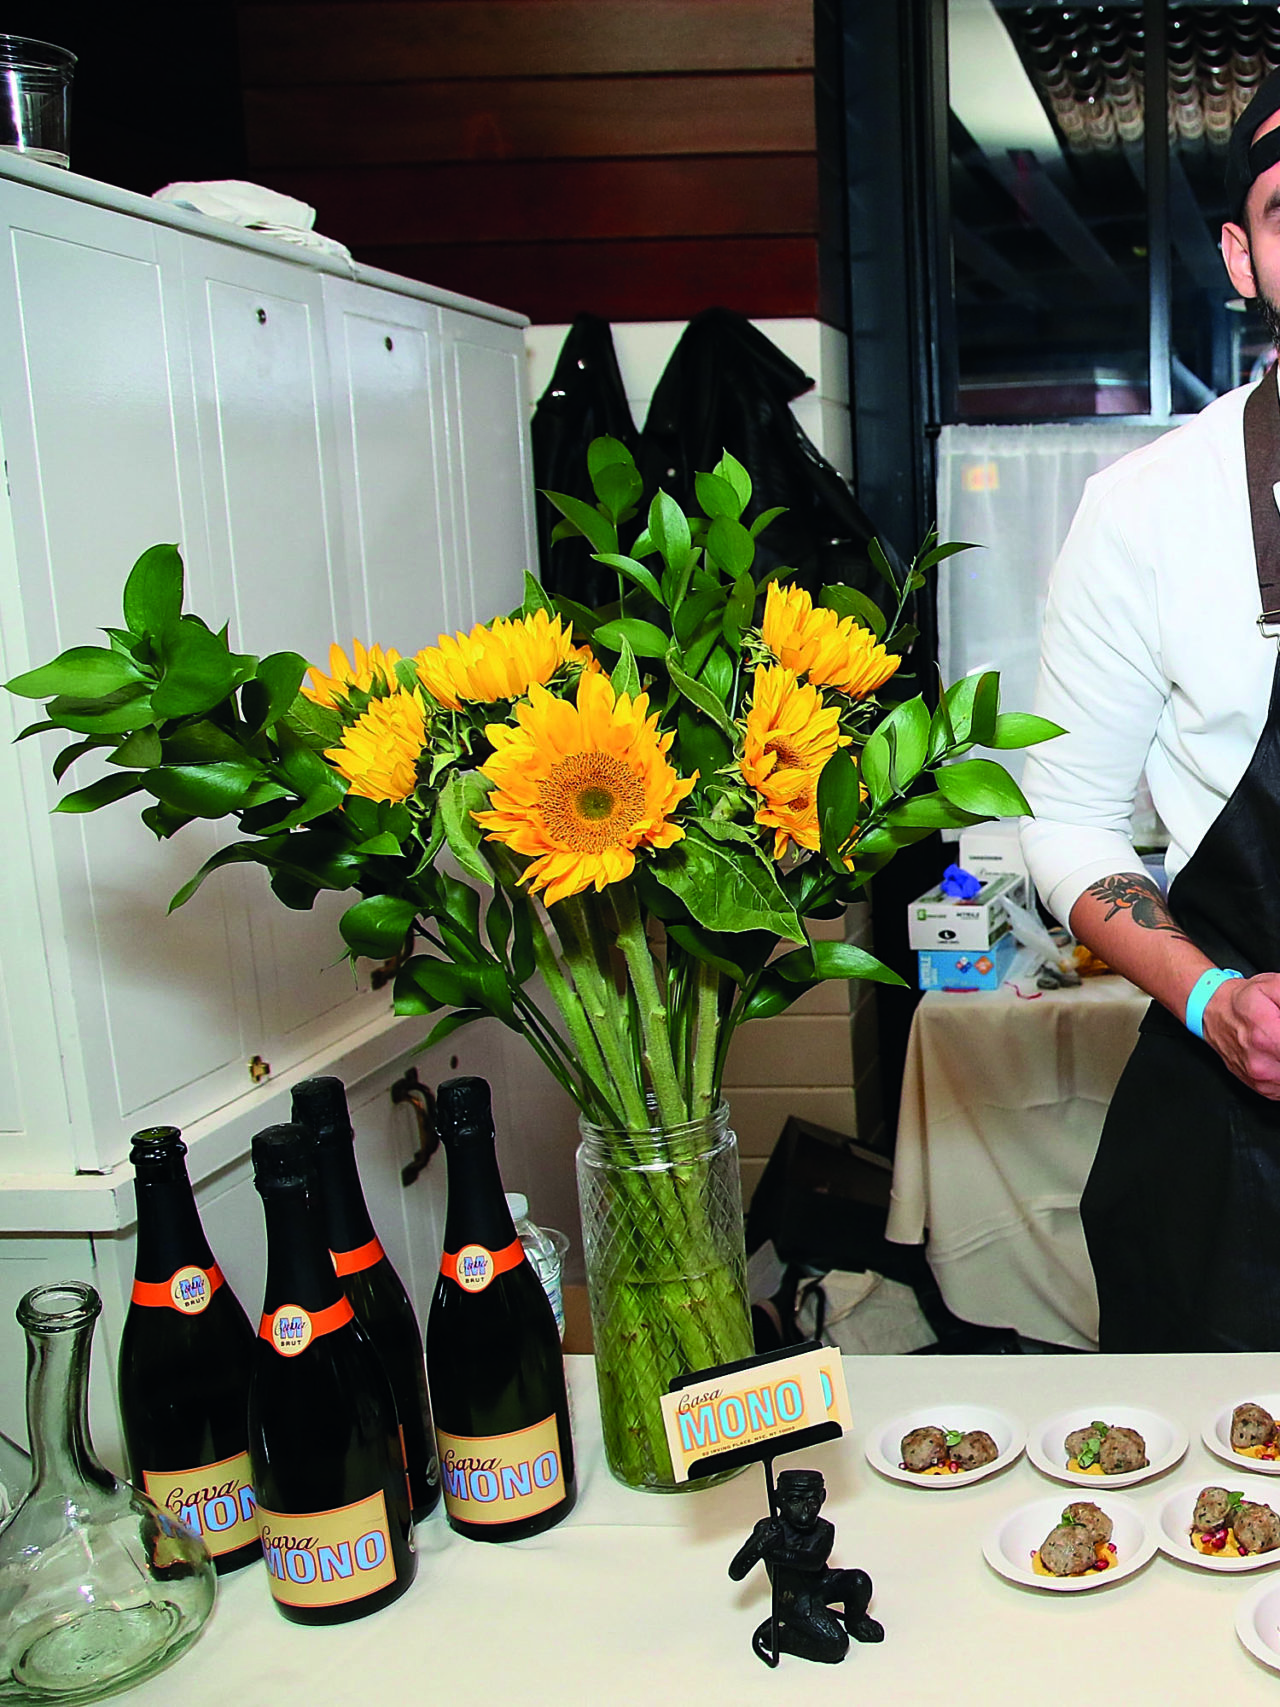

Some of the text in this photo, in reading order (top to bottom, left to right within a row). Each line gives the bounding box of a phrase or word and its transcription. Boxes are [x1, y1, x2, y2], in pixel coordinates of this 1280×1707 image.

[184, 1297, 205, 1307] BRUT
[678, 1387, 724, 1415] Casa
[676, 1379, 804, 1453] MONO
[444, 1449, 502, 1473] Cava
[710, 1445, 731, 1454] IRVING
[442, 1450, 559, 1503] MONO
[166, 1479, 239, 1515] Cava
[261, 1525, 319, 1550] Cava
[262, 1529, 386, 1584] MONO
